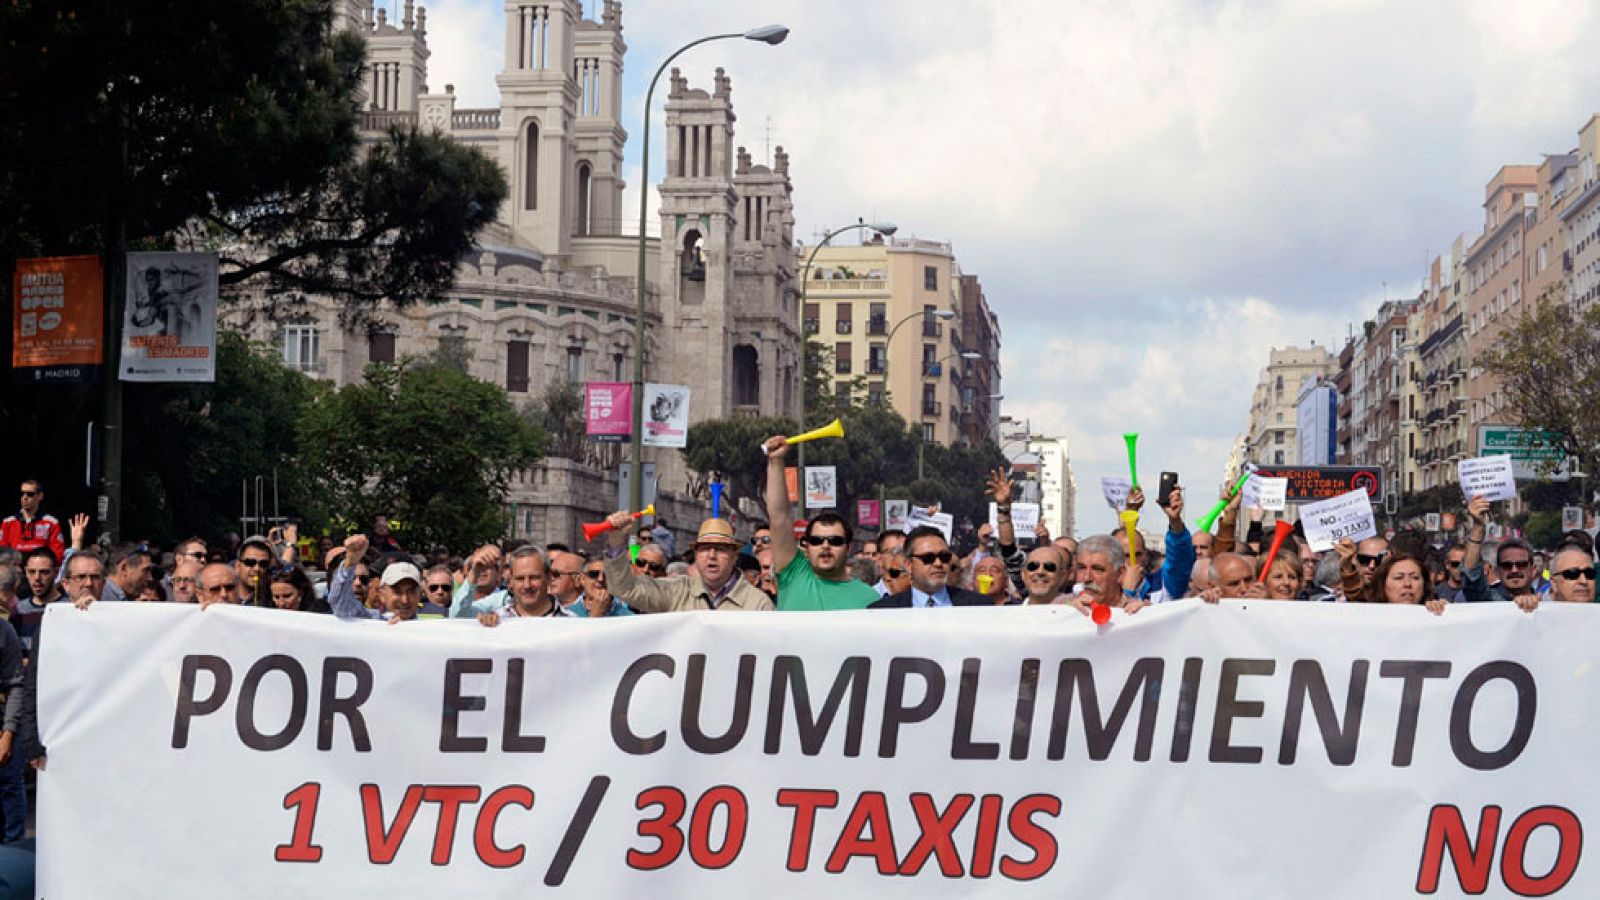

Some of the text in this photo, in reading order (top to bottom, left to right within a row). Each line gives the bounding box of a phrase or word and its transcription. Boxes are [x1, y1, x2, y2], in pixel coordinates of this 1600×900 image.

[21, 295, 64, 309] OPEN
[45, 369, 81, 379] MADRID
[1294, 479, 1344, 487] VICTORIA
[1356, 478, 1373, 490] 50
[1320, 515, 1336, 526] NO
[1344, 519, 1371, 536] TAXIS
[171, 653, 1538, 770] POR EL CUMPLIMIENTO
[274, 776, 1583, 897] 1 VTC / 30 TAXIS NO
